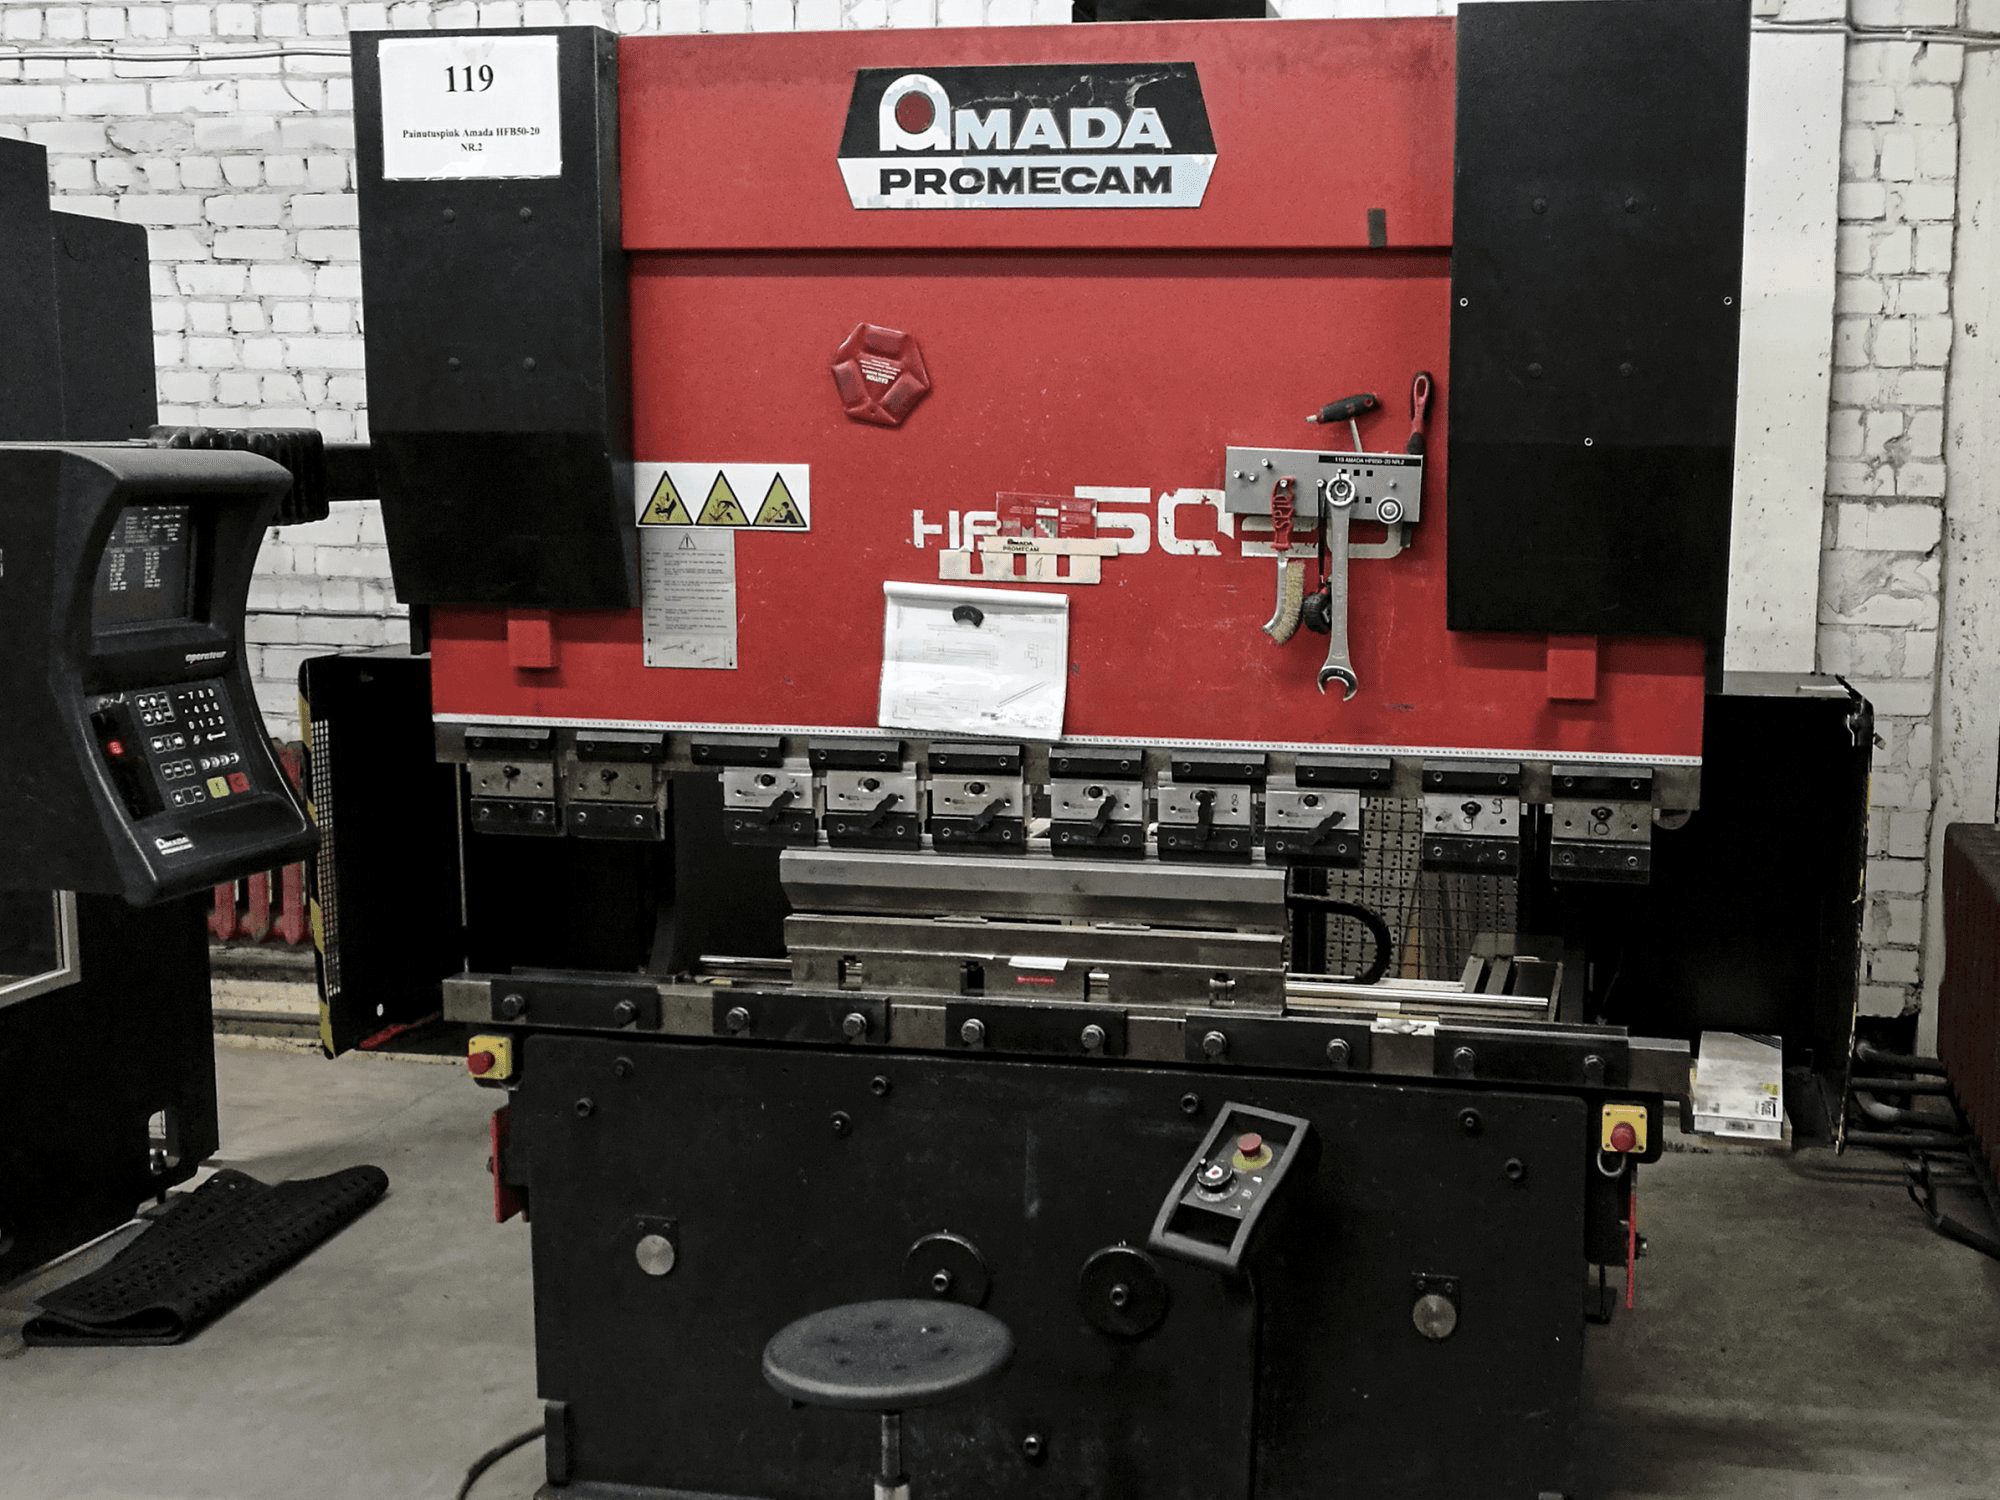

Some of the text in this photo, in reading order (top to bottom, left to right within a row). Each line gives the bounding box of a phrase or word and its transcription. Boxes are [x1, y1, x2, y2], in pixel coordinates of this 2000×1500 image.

[445, 64, 494, 92] 119
[879, 73, 1172, 151] AMADA
[402, 126, 540, 140] Painutuspink Amada HFB50-20
[460, 142, 483, 152] NR.2
[879, 165, 1172, 195] PROMECAM
[1231, 793, 1239, 807] 8
[1588, 820, 1610, 836] 10
